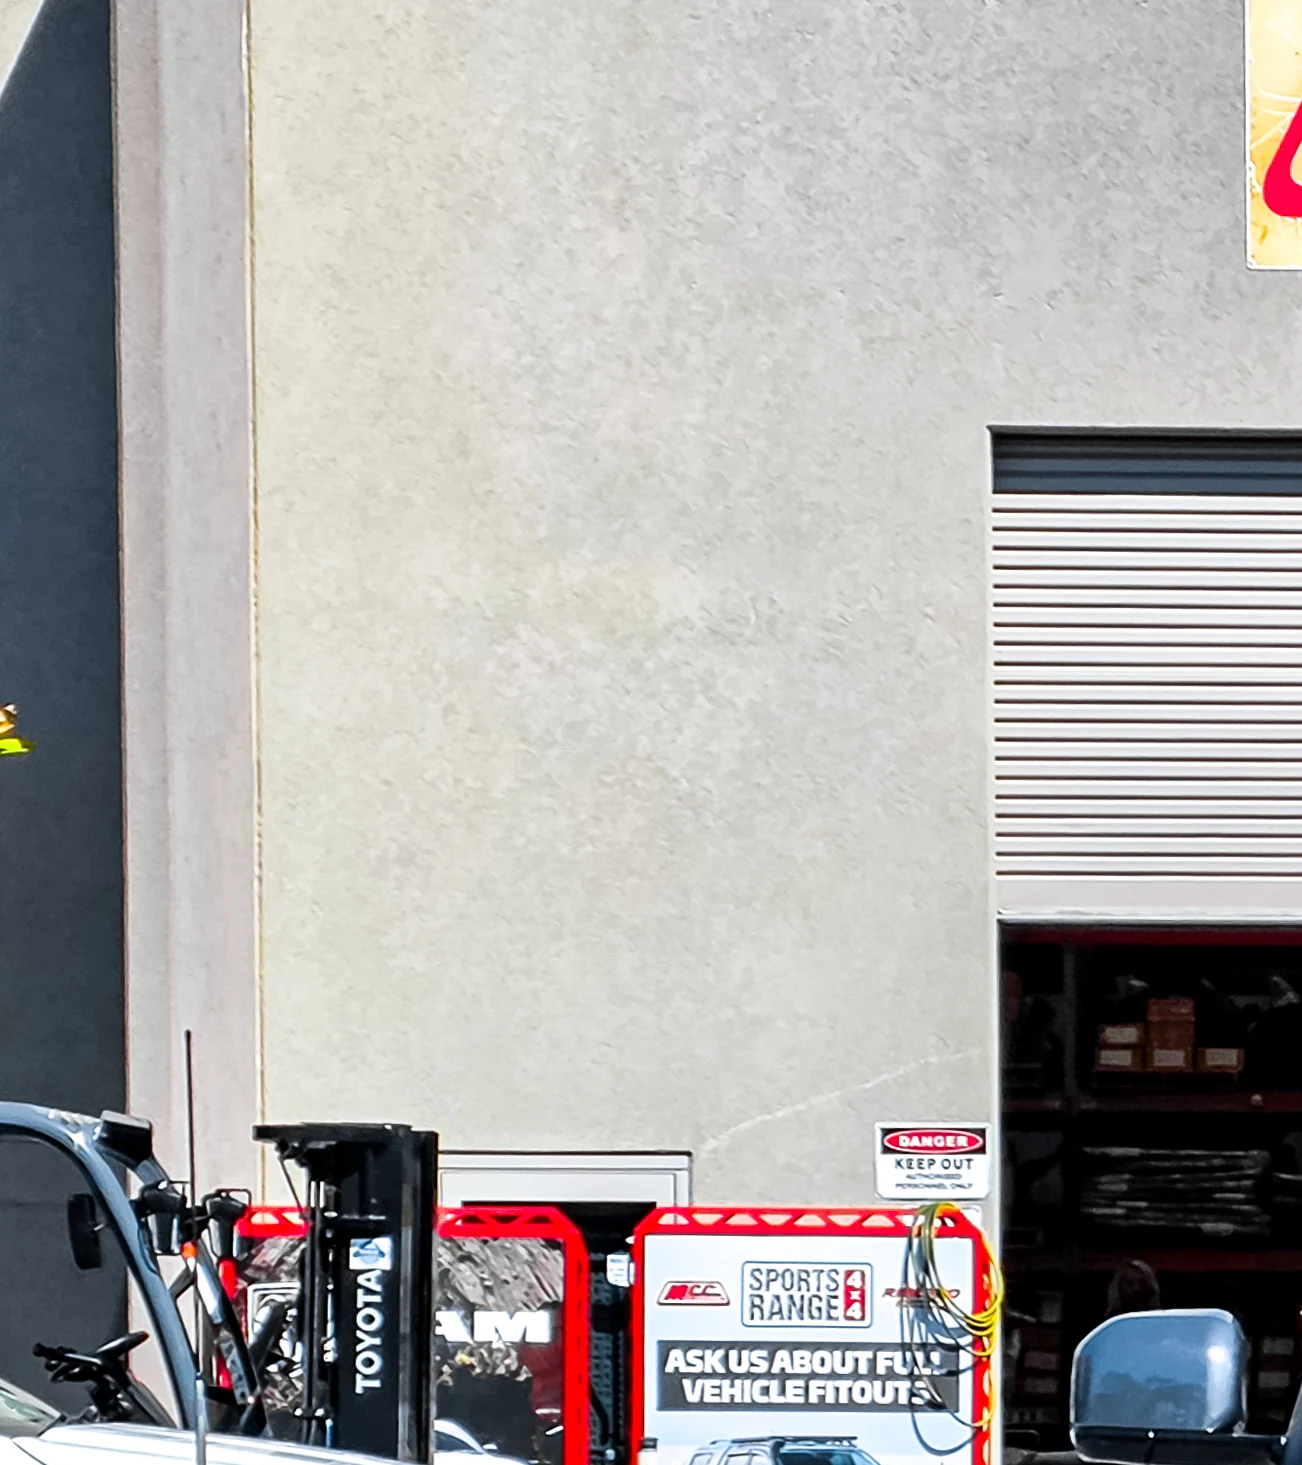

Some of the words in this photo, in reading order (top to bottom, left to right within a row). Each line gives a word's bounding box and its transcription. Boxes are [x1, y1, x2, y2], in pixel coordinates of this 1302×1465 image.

[898, 1136, 969, 1148] DANGER
[895, 1158, 936, 1170] KEEP
[941, 1158, 974, 1170] OUT
[749, 1268, 840, 1292] SPORTS
[749, 1295, 840, 1321] RANGE
[355, 1269, 382, 1394] TOYOTA
[665, 1349, 727, 1373] ASK
[728, 1350, 769, 1374] US
[771, 1350, 874, 1374] ABOUT
[681, 1379, 807, 1404] VEHICLE
[808, 1380, 933, 1405] FITOUTS
